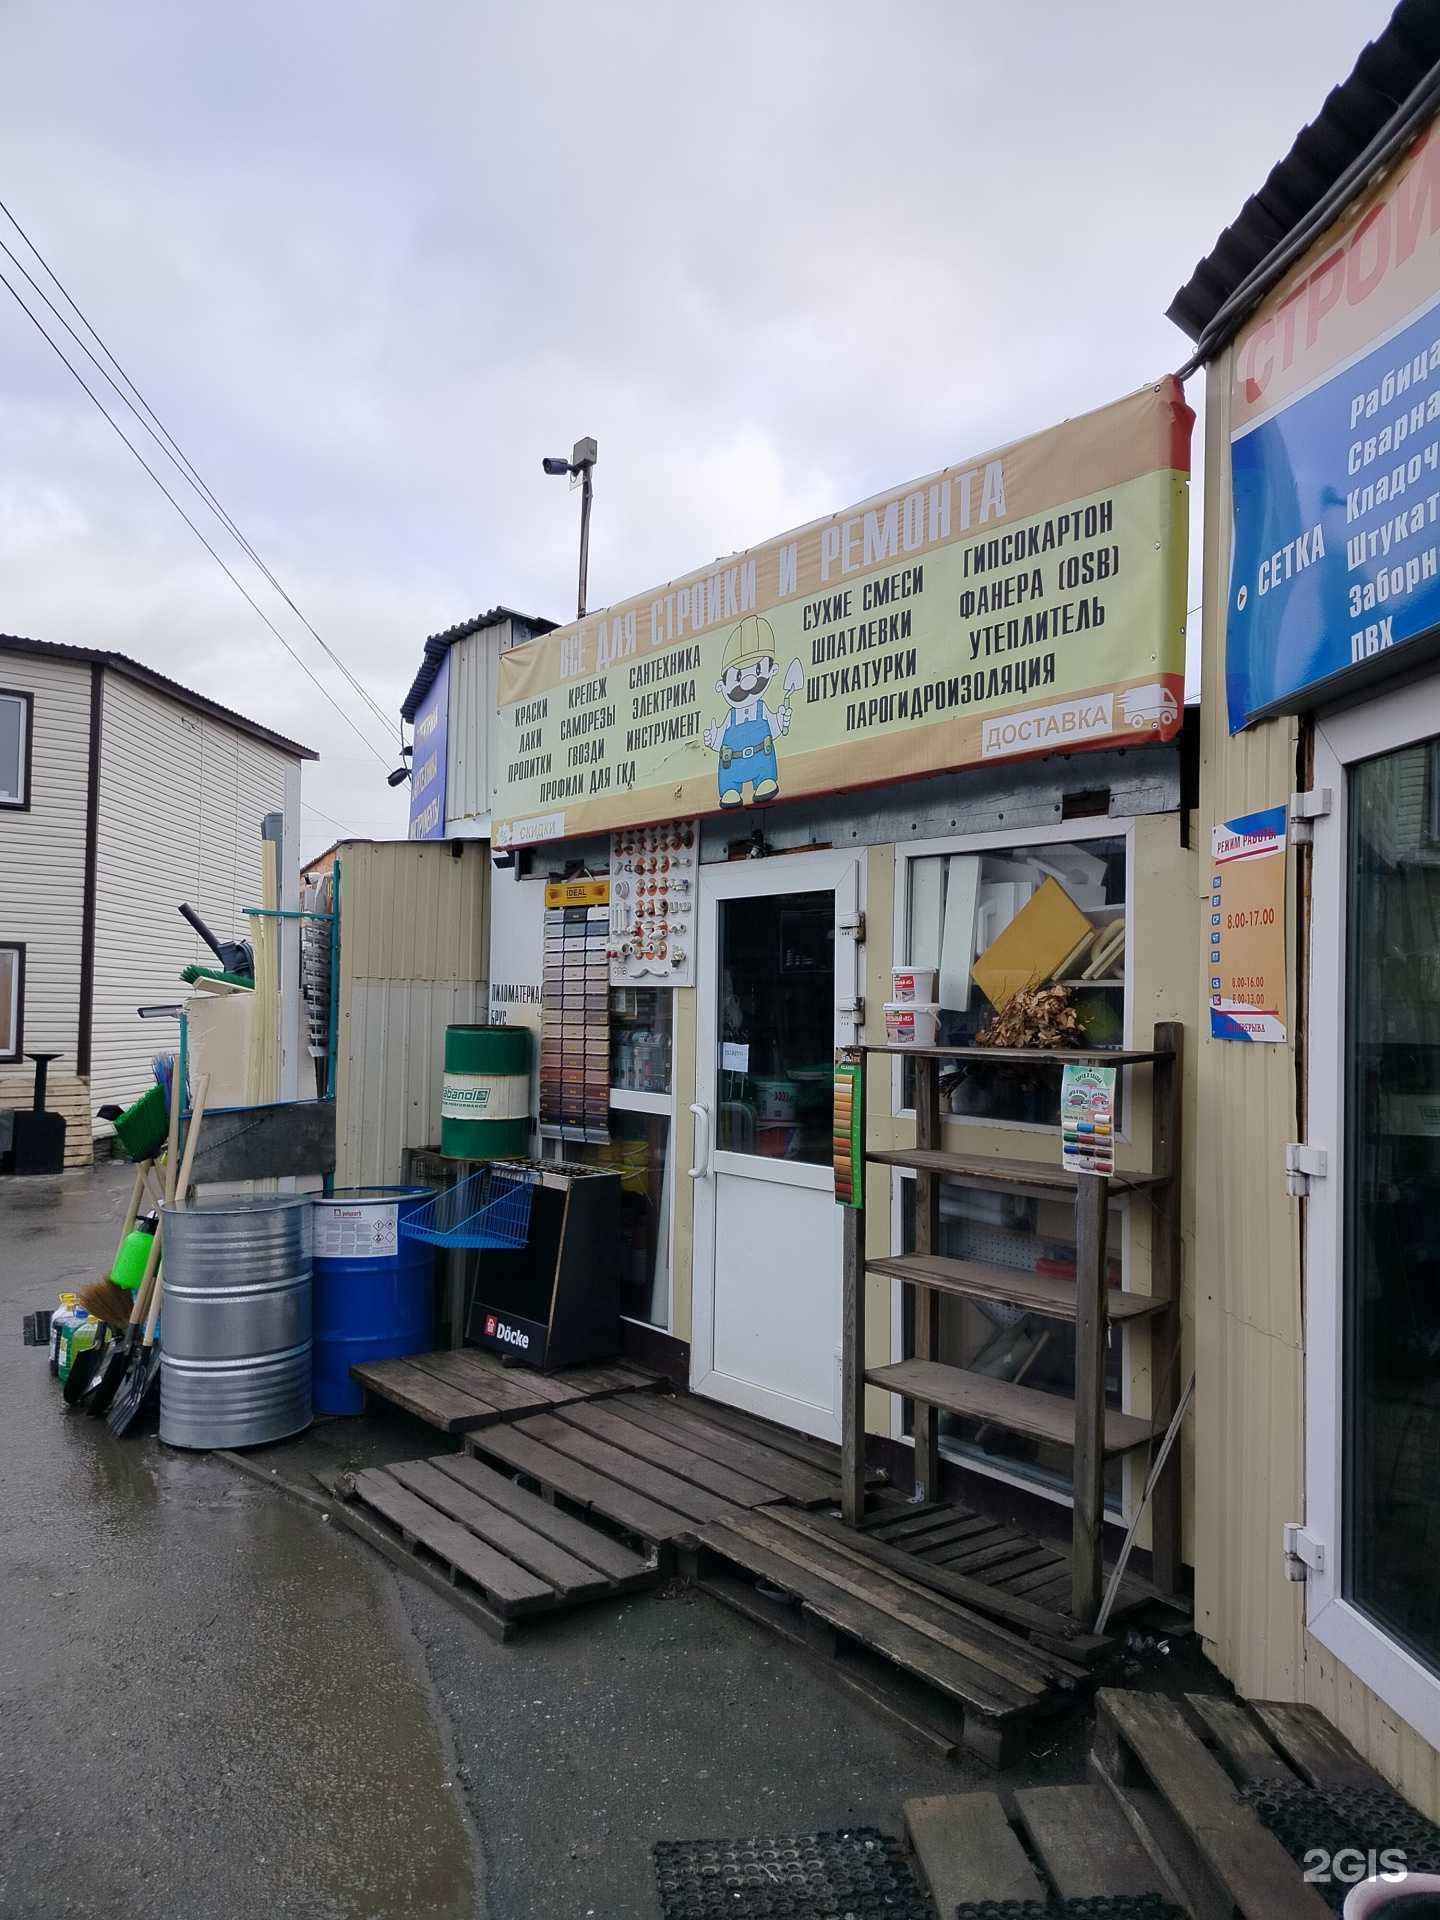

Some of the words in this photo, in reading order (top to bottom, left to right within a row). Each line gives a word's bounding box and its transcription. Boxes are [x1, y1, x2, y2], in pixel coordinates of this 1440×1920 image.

[1350, 339, 1440, 430] Рабица
[1348, 390, 1440, 476] Сварна
[1346, 441, 1439, 524] Кладоч
[963, 500, 1113, 578] ГИПСОКАРТОН
[1346, 493, 1440, 572] Штукат
[596, 611, 638, 670] ДЛЯ
[777, 542, 798, 597] И
[820, 459, 1007, 582] РЕМОНТА
[959, 568, 1044, 620] ФАНЕРА
[1058, 544, 1120, 591] (OSB)
[1257, 523, 1326, 597] СЕТКА
[1349, 547, 1438, 618] Заборн
[802, 590, 853, 632] СУХИЕ
[862, 565, 924, 611] СМЕСИ
[812, 610, 912, 665] ШПАТЛЕВКИ
[969, 596, 1105, 660] УТЕПЛИТЕЛЬ
[1350, 615, 1393, 664] ПВХ
[629, 645, 702, 690] САНТЕХНИКА
[807, 648, 917, 704] ШТУКАТУРКИ
[514, 698, 549, 727] КРАСКИ
[568, 677, 608, 710] КРЕПЕЖ
[632, 680, 696, 720] ЭЛЕКТРИКА
[846, 653, 1056, 731] ПАРОГИДРОИЗОЛЯЦИЯ
[519, 728, 543, 754] ЛАКИ
[560, 704, 616, 741] САМОРЕЗЫ
[626, 710, 702, 752] ИНСТРУМЕНТ
[985, 704, 1109, 752] ДОСТАВКА
[508, 753, 552, 784] ПРОПИТКИ
[567, 738, 605, 768] ГВОЗДИ
[539, 774, 585, 803] ПРОФИЛИ
[589, 767, 611, 795] ДЛЯ
[616, 760, 636, 786] ГКЛ
[519, 820, 556, 840] СКИДКИ
[566, 888, 587, 897] IDEAL
[1227, 908, 1275, 929] 8.00-17.00
[496, 1322, 529, 1349] Döcke
